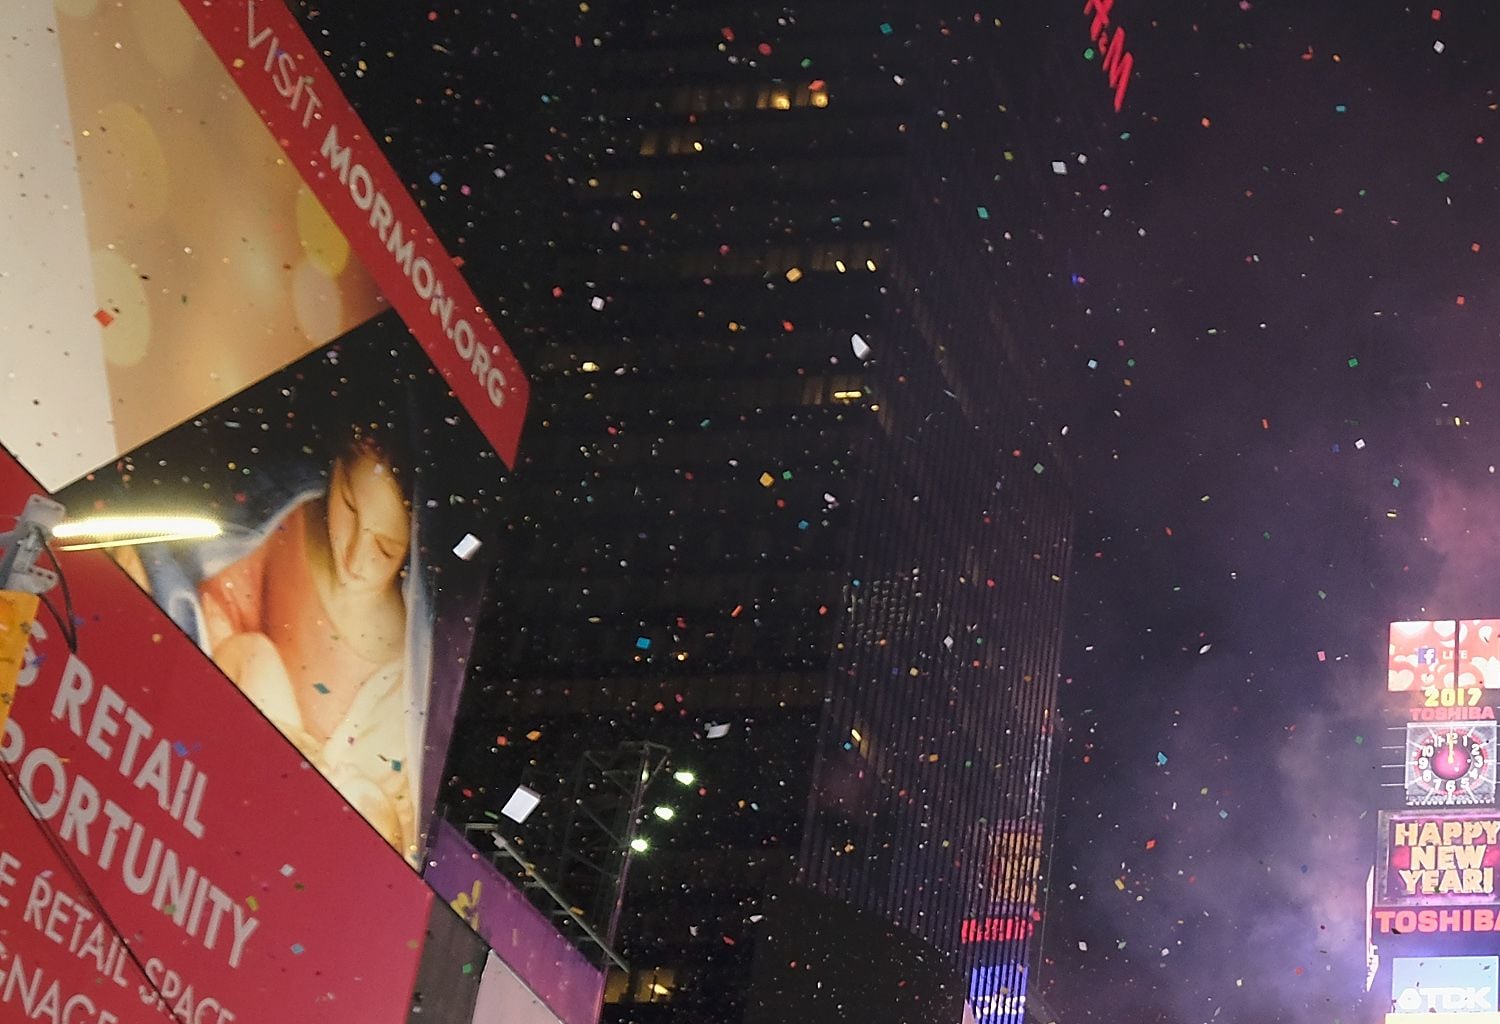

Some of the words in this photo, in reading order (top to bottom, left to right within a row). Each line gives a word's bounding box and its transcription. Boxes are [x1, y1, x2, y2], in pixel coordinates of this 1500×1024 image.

[248, 0, 323, 128] VISIT
[320, 124, 507, 407] MORMON.ORG
[1424, 687, 1482, 707] 2017
[1410, 706, 1495, 720] TOSHIBA
[51, 652, 208, 838] RETAIL
[1421, 745, 1434, 758] 10
[1471, 744, 1480, 755] 2
[1473, 755, 1483, 768] 3
[1446, 780, 1456, 793] 6
[1410, 844, 1487, 871] NEW
[1398, 868, 1495, 895] YEAR!
[23, 875, 129, 988] RETAIL
[1427, 986, 1493, 1011] TDK
